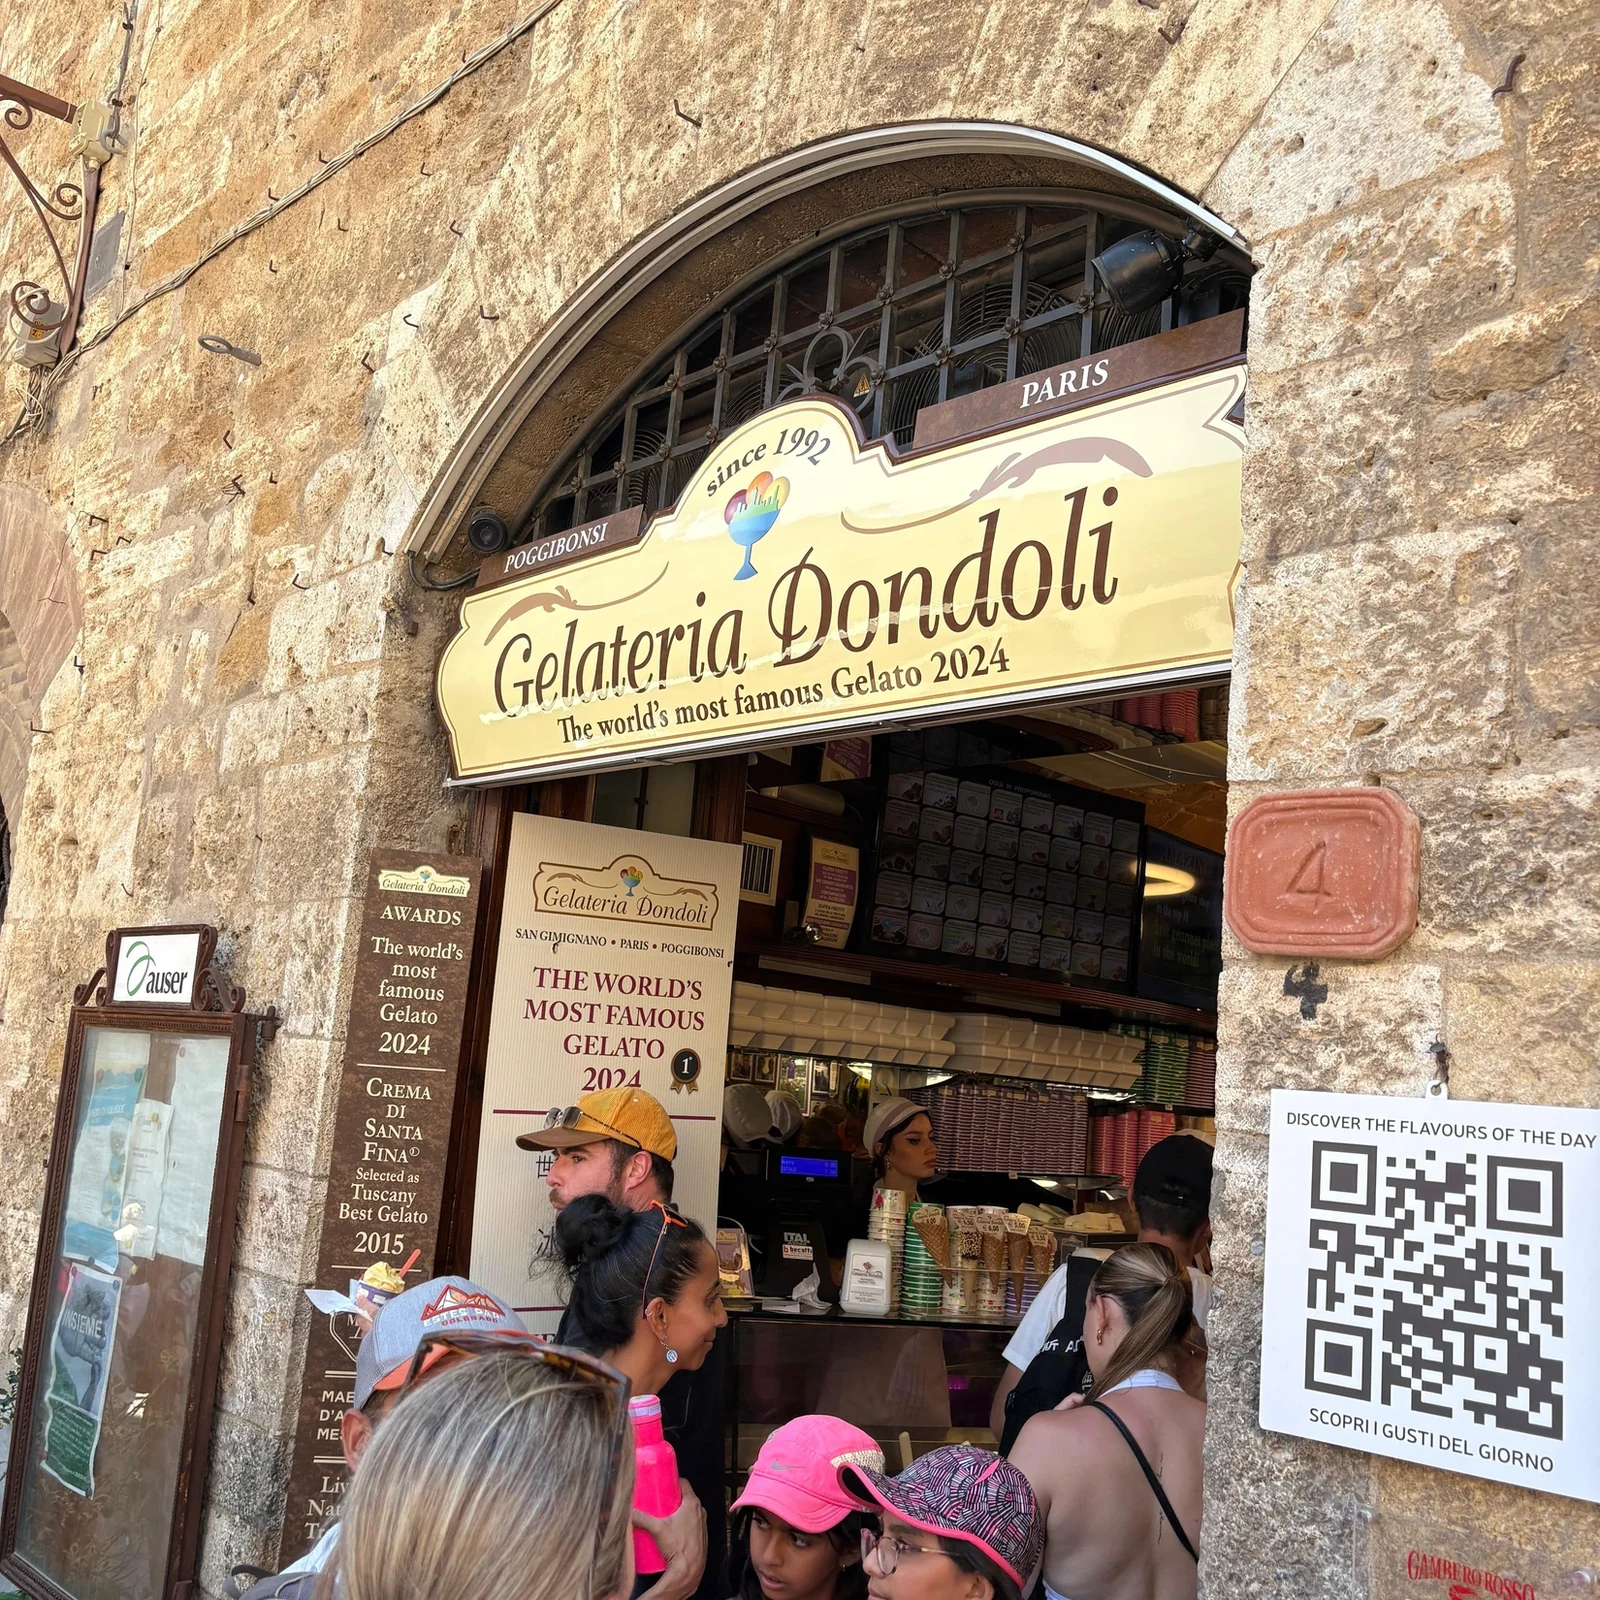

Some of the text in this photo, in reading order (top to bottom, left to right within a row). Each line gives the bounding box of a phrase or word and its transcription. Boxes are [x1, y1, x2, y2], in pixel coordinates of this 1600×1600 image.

[1019, 359, 1110, 408] PARIS
[706, 427, 831, 497] since 1992
[503, 523, 608, 573] POGGIBONSI
[494, 486, 1119, 717] Gelateria Dondoli
[557, 637, 1010, 744] The world's most famous Gelato 2024
[382, 879, 467, 895] Gelateria Dondoli
[1285, 840, 1332, 914] 4
[380, 905, 463, 926] AWARDS
[543, 886, 709, 924] Gelateria Dondoli
[371, 936, 464, 961] The world's
[515, 928, 725, 958] SAN GIMIGNANO PARIS POGGIBONSI
[146, 971, 188, 994] auser
[391, 963, 437, 980] most
[533, 966, 702, 1001] THE WORLD'S
[378, 979, 445, 1001] famous
[379, 1003, 438, 1025] Gelato
[523, 999, 705, 1031] MOST FAMOUS
[378, 1032, 431, 1057] 2024
[563, 1034, 665, 1059] GELATO
[366, 1077, 432, 1100] CREMA
[581, 1067, 642, 1092] 2024
[385, 1104, 406, 1119] DI
[364, 1118, 423, 1141] SANTA
[1286, 1111, 1598, 1149] DISCOVER THE FLAVOURS OF THE DAY
[355, 1167, 420, 1183] Selected as
[536, 1155, 553, 1179] 世
[351, 1183, 417, 1208] Tuscany
[339, 1203, 428, 1224] Best Gelato
[353, 1231, 405, 1255] 2015
[424, 1308, 468, 1328] ESTES
[440, 1315, 499, 1326] COLORADO
[1309, 1407, 1555, 1473] SCOPRI I GUSTI DEL GIORNO
[1407, 1550, 1536, 1600] GAMBERO ROSSO
